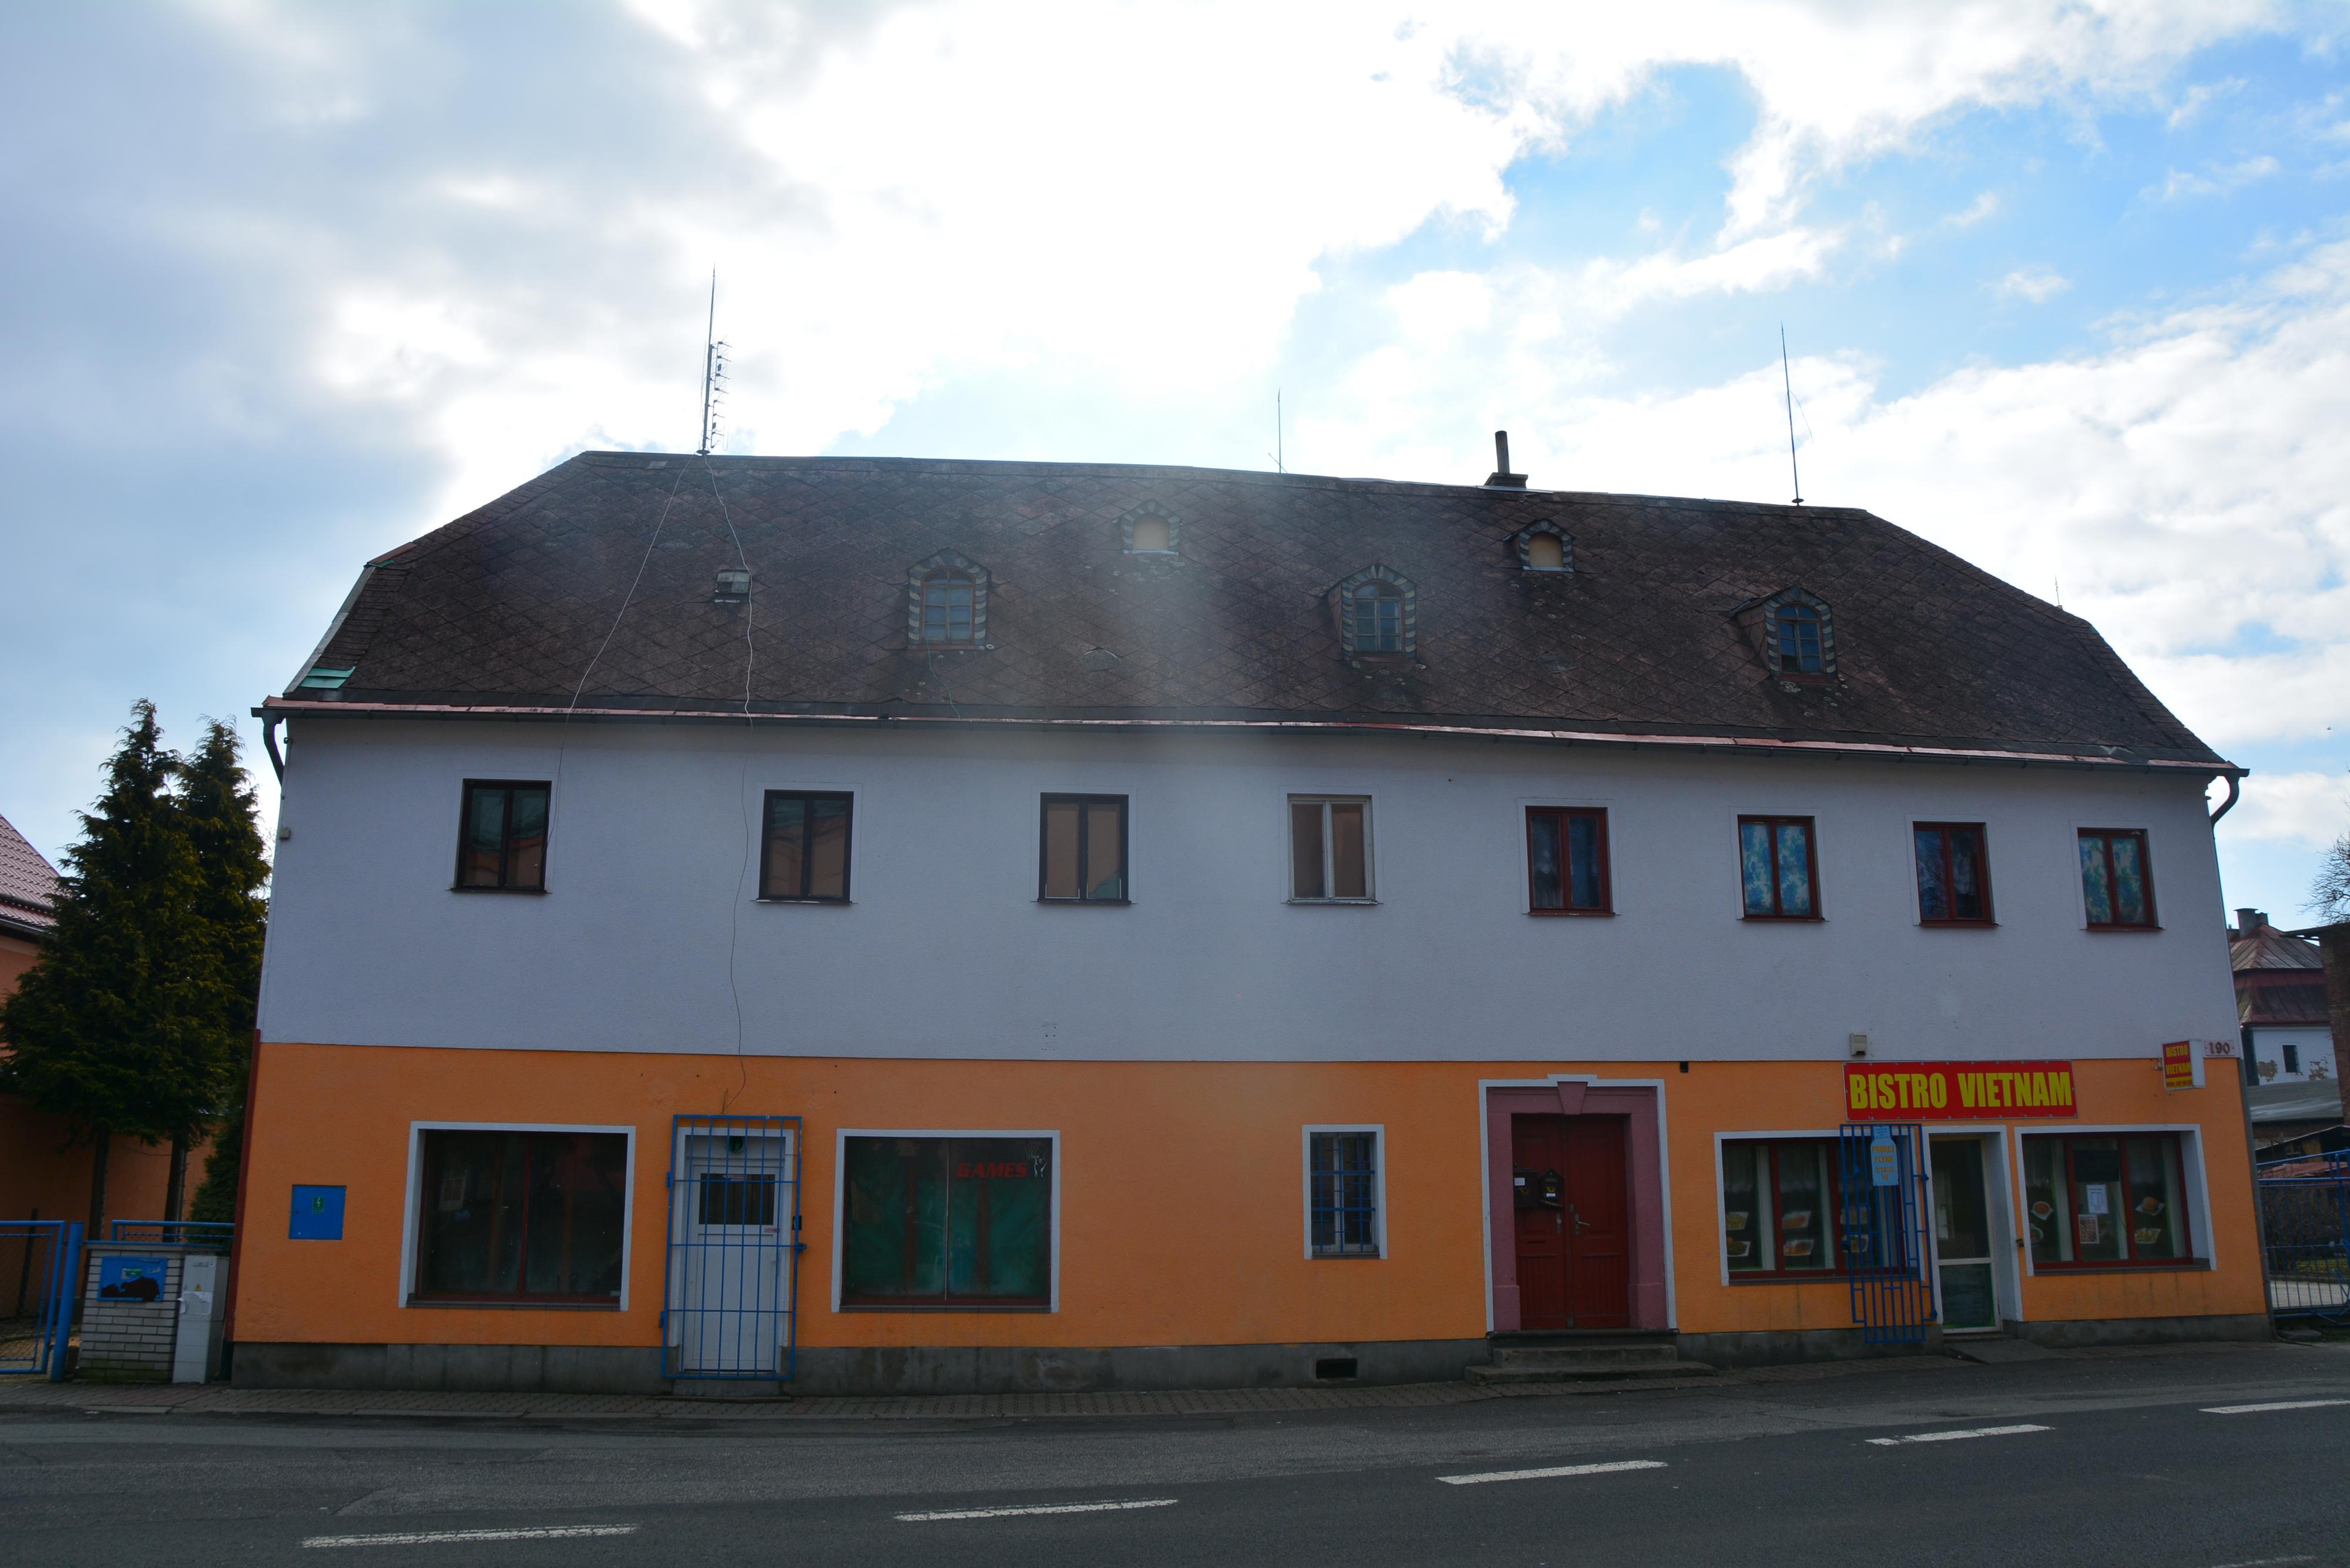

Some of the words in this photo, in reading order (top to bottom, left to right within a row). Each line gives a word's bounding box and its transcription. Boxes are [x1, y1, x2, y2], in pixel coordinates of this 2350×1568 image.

[2210, 1042, 2230, 1054] 190
[2166, 1062, 2191, 1075] VIETNAM
[1849, 1073, 1947, 1109] BISTRO
[1958, 1072, 2072, 1107] VIETNAM
[956, 1161, 1029, 1178] GAMES
